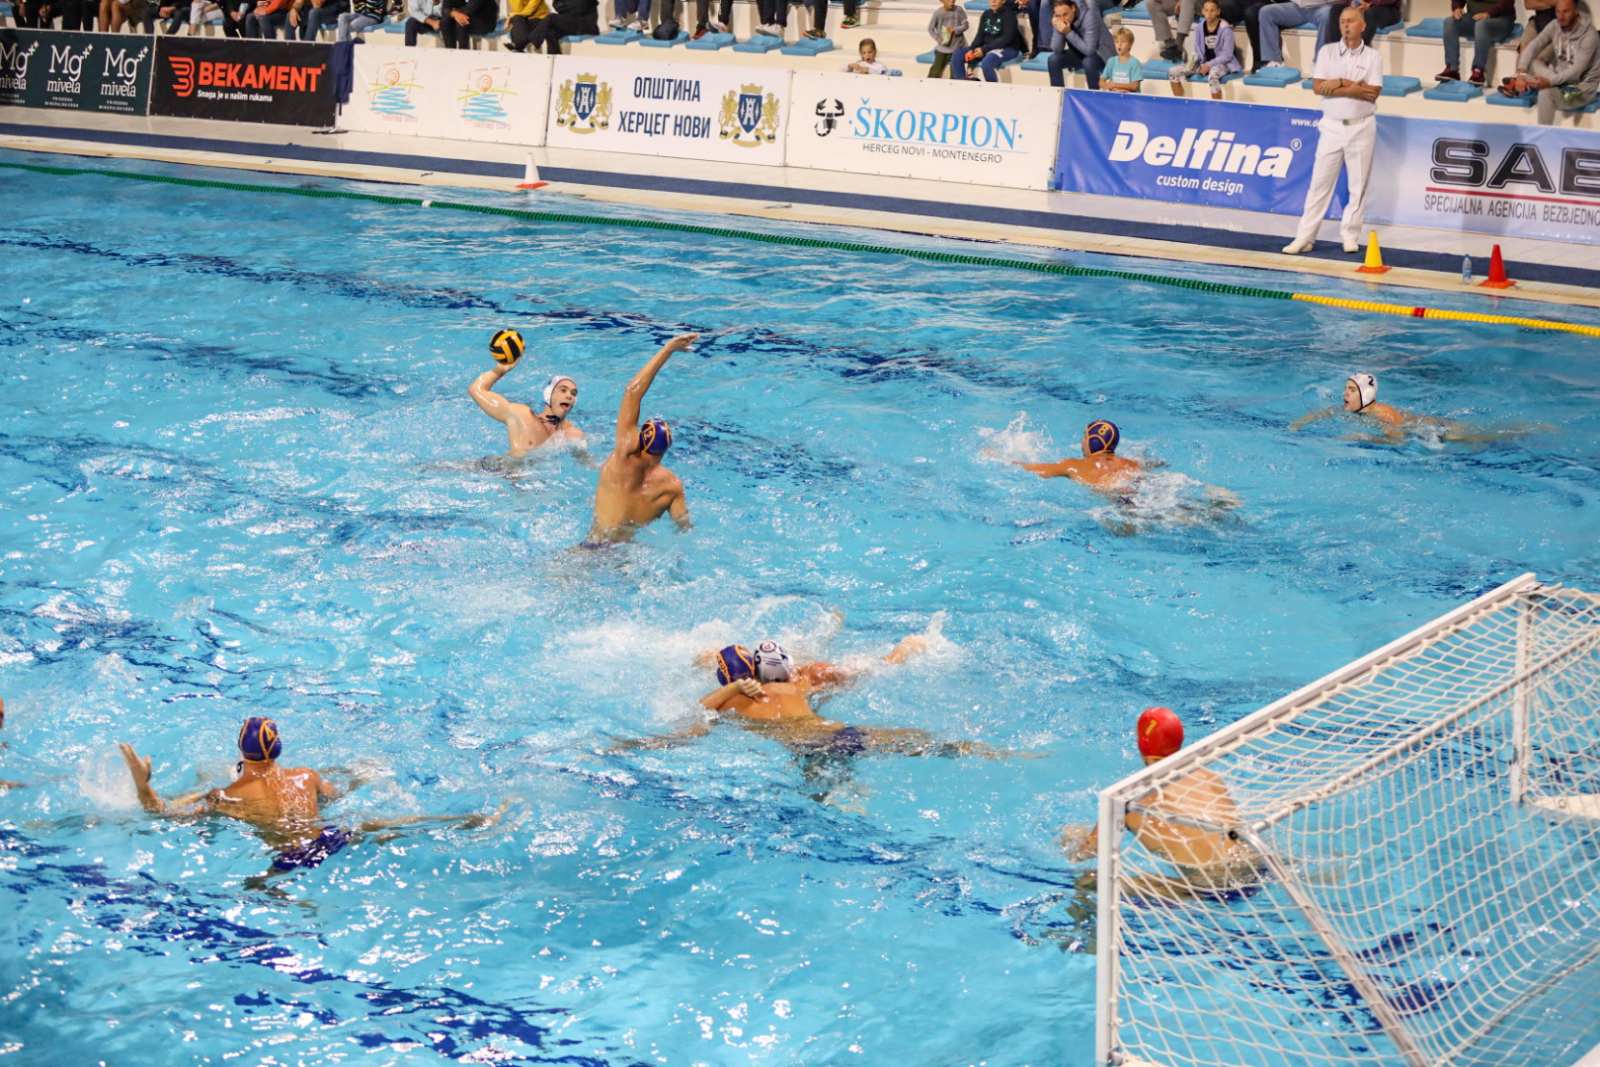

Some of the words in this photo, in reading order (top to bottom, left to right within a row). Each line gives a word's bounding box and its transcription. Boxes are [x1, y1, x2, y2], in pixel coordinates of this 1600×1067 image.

[47, 77, 81, 94] mivela
[100, 81, 137, 98] mivela
[633, 76, 701, 102] ОПШТИНА
[617, 111, 670, 137] ХЕРЦЕГ
[673, 115, 711, 139] НОВИ
[862, 143, 900, 154] HERCEG
[900, 146, 926, 156] NOVI
[931, 148, 1003, 164] MONTENEGRO
[1156, 174, 1199, 190] custom
[1202, 178, 1244, 196] design
[1424, 194, 1483, 216] SPECIJALNA
[1487, 200, 1537, 220] AGENCIJA
[1368, 375, 1374, 386] 2
[1098, 424, 1108, 435] 8
